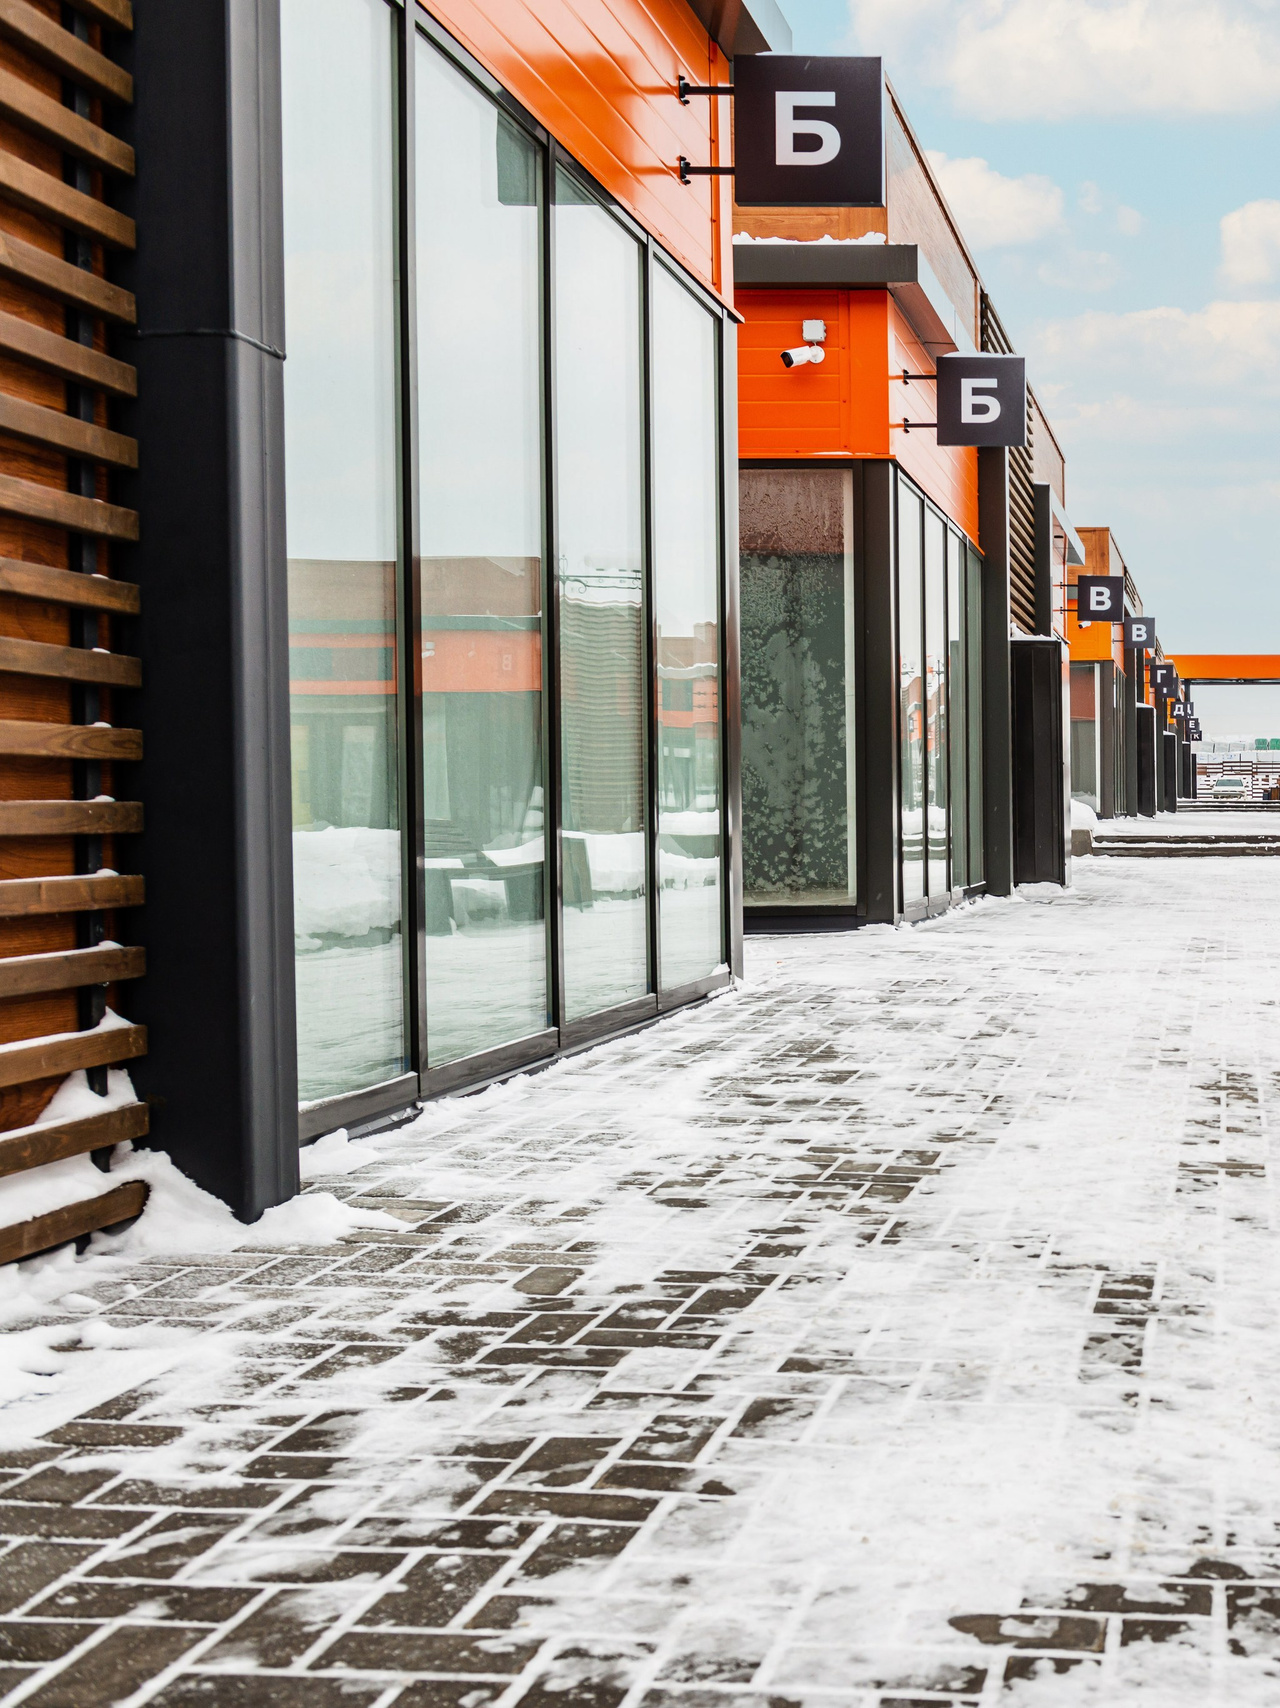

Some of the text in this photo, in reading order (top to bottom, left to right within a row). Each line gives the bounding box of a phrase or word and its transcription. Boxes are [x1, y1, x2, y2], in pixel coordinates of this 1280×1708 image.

[775, 91, 841, 166] Б
[961, 378, 1002, 424] Б
[1089, 586, 1112, 611] В
[1131, 624, 1148, 642] В
[1156, 669, 1167, 683] Г
[1173, 704, 1185, 717] Д
[1189, 720, 1195, 729] Е
